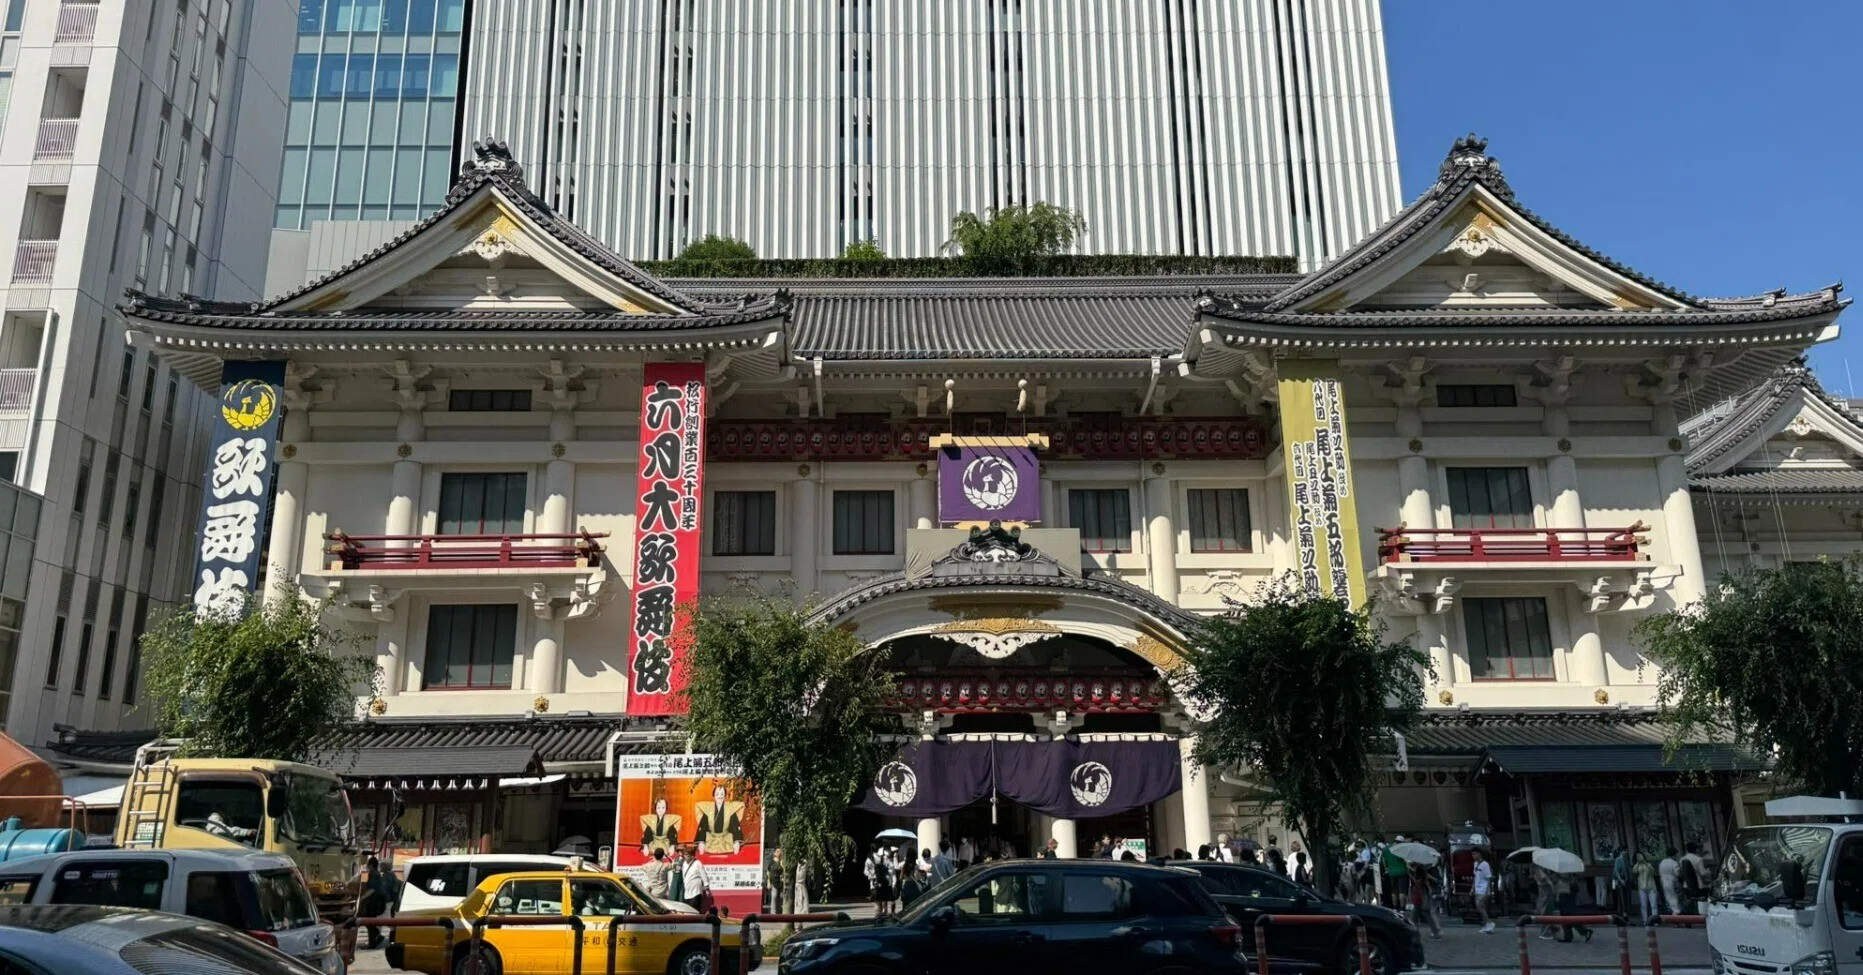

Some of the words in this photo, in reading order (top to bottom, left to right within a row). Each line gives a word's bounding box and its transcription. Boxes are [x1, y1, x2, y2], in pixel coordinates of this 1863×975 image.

[681, 381, 701, 530] 松竹創業百三十周年
[634, 381, 684, 693] 六月大歌舞伎
[1737, 944, 1765, 957] ISUZU
